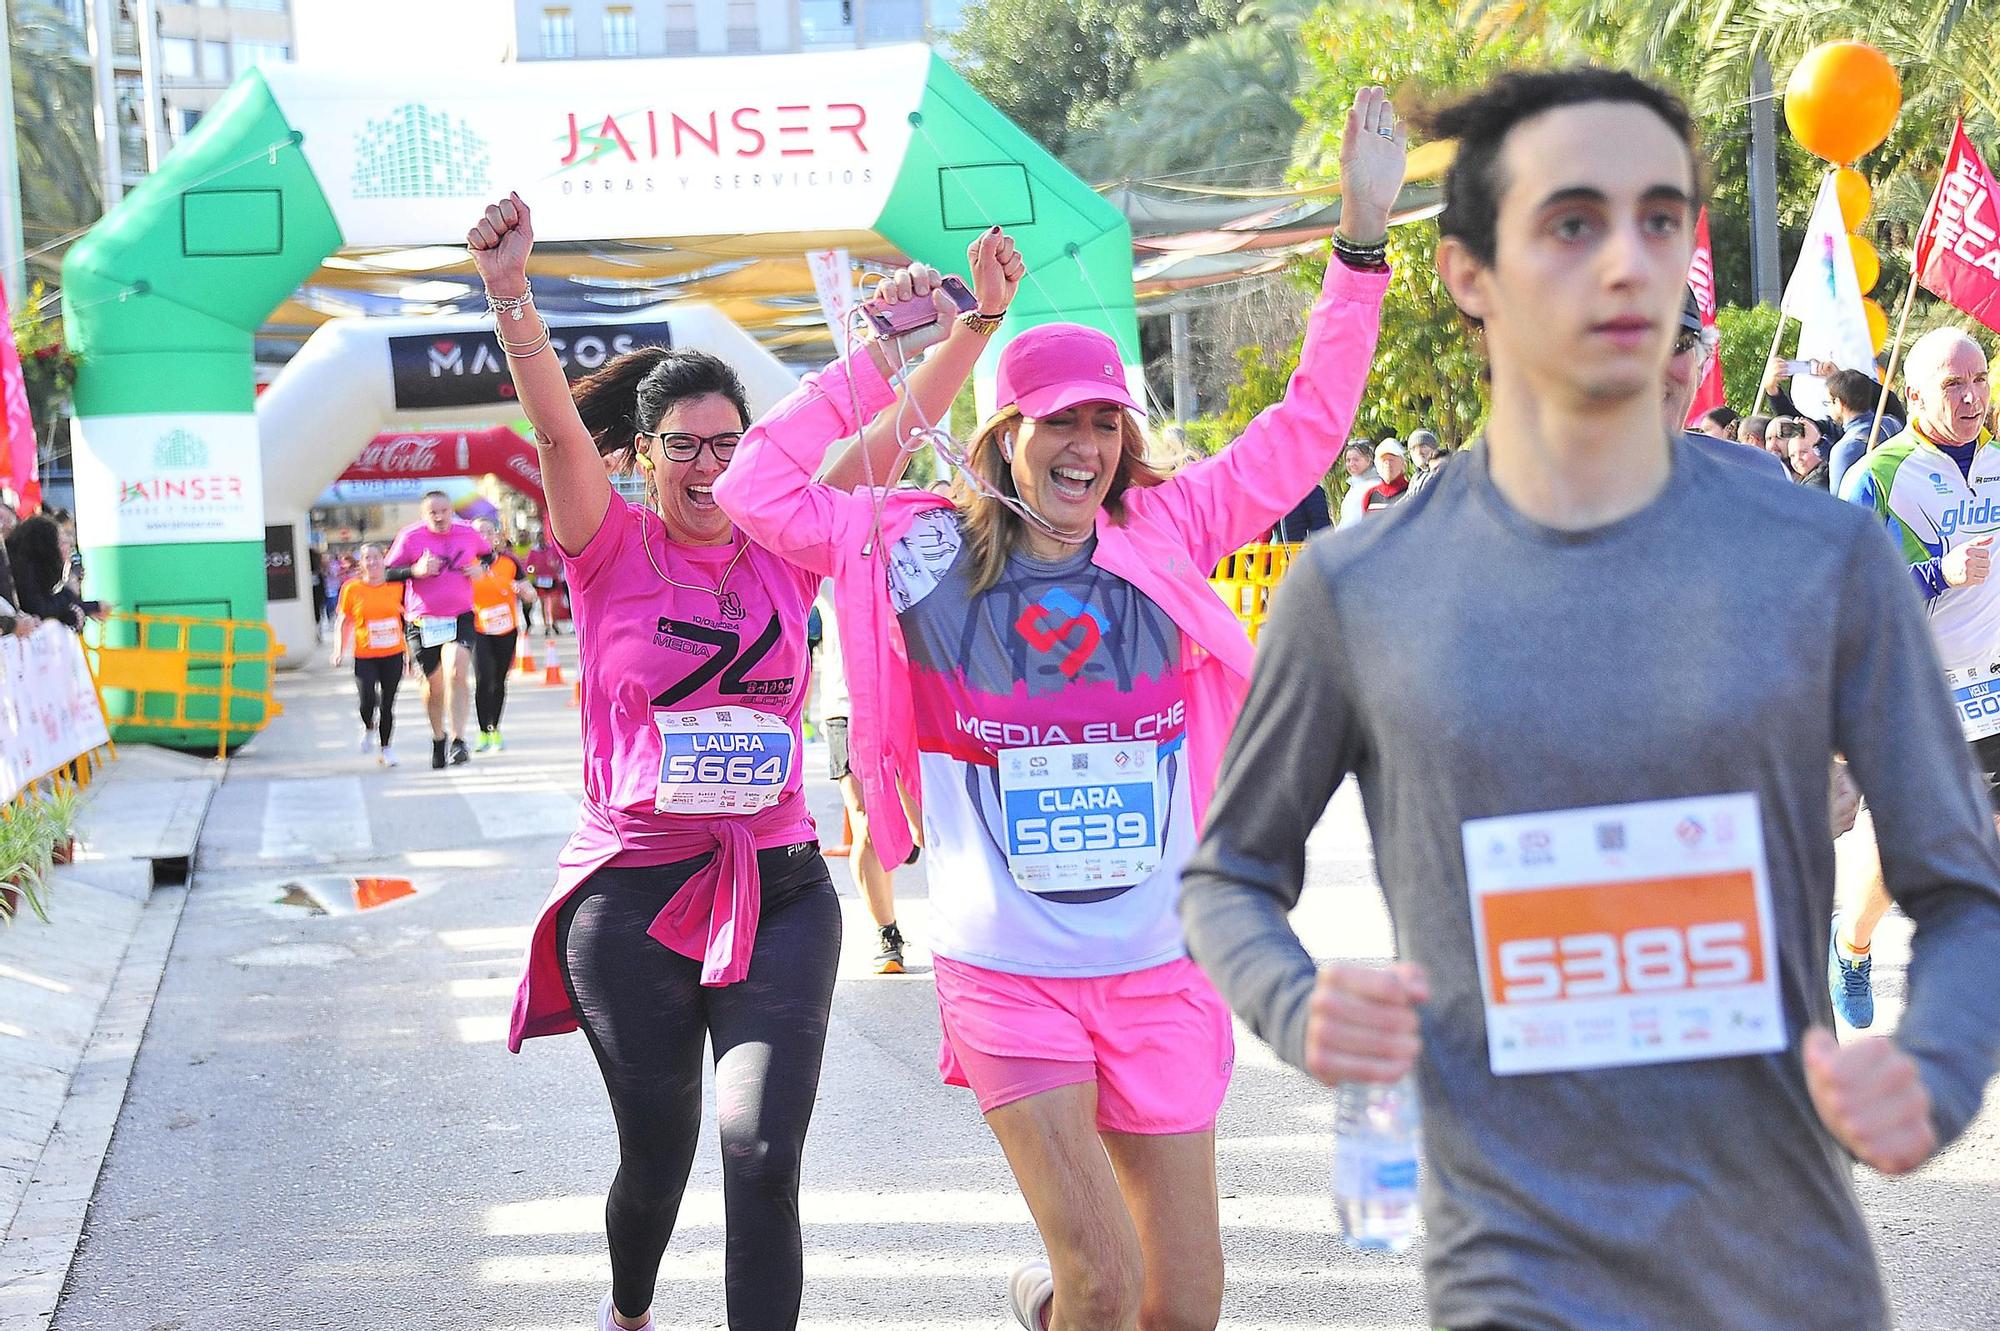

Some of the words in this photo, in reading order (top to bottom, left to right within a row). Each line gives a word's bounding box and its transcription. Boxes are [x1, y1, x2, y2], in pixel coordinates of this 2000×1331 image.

[560, 103, 869, 166] JAINSER
[562, 178, 655, 195] OBRAS
[679, 176, 689, 190] Y
[713, 169, 872, 190] SERVICIOS
[120, 476, 242, 503] JAINSER
[652, 633, 710, 658] MEDIA
[955, 711, 1070, 745] MEDIA
[1083, 700, 1184, 743] ELCHE
[691, 734, 765, 752] LAURA
[667, 755, 781, 784] 5664
[1038, 786, 1124, 812] CLARA
[1015, 812, 1148, 854] 5639
[1500, 921, 1751, 1000] 5385
